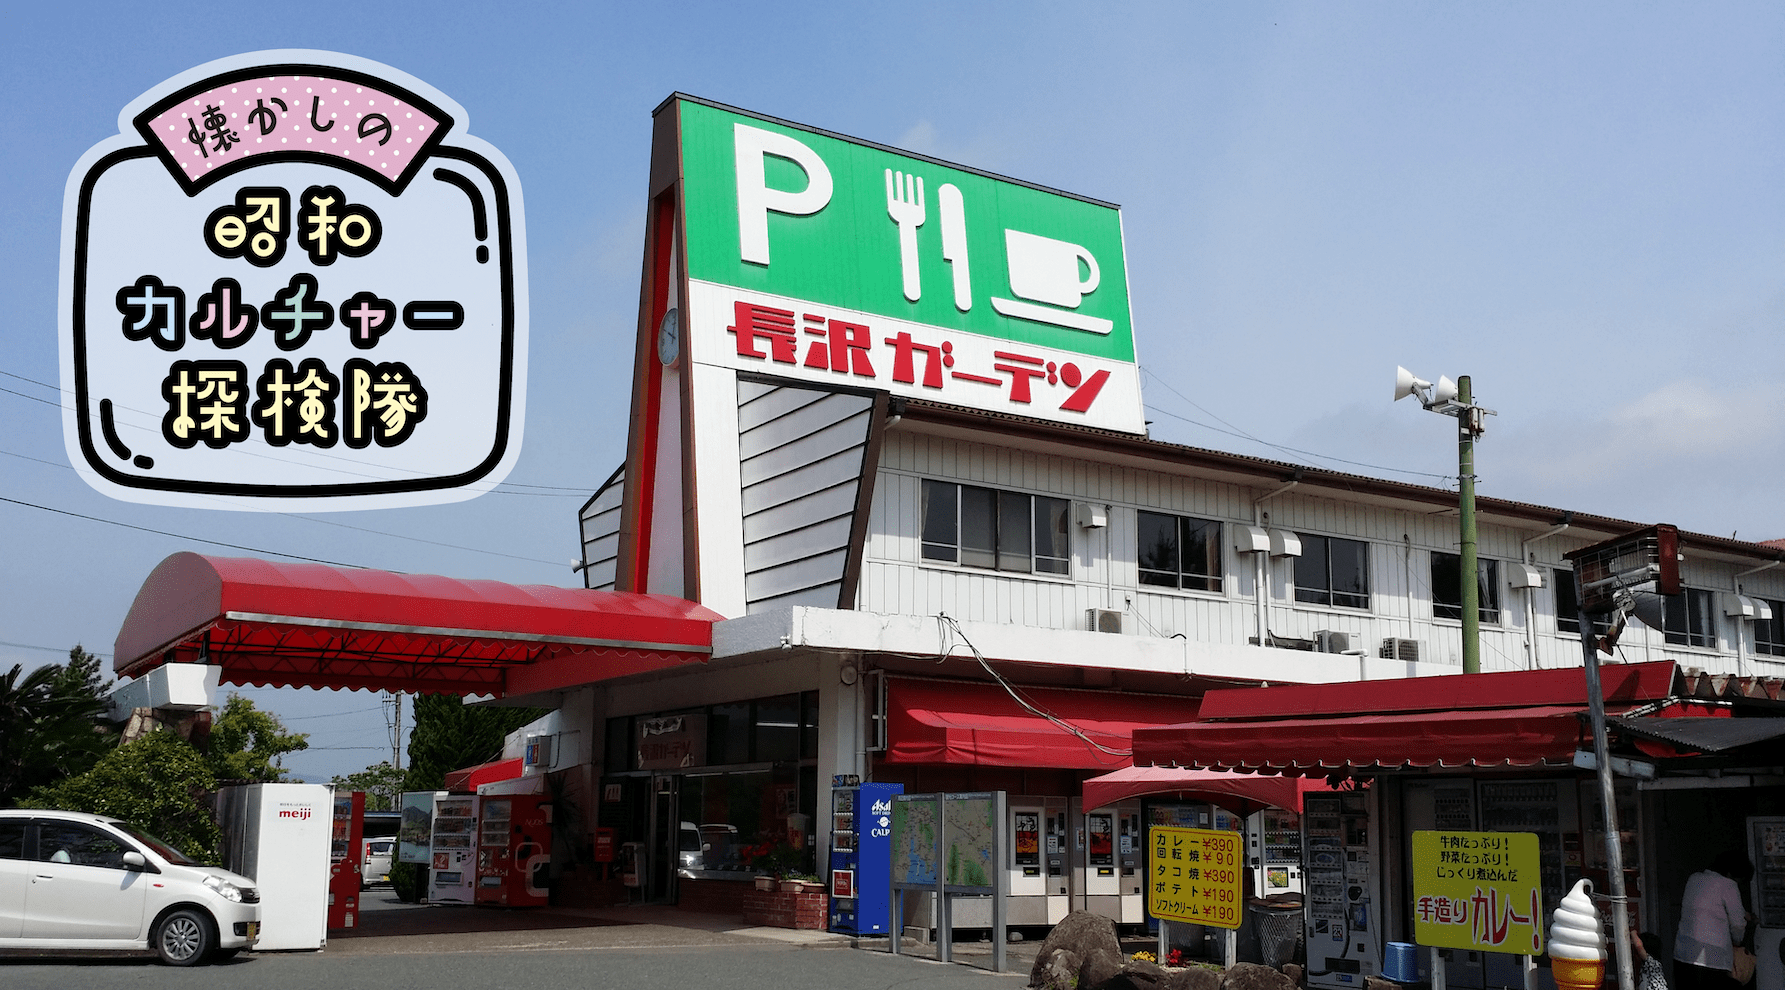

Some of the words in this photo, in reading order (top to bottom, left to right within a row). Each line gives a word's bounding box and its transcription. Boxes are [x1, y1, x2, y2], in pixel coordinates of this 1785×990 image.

[733, 122, 834, 266] P
[727, 300, 1111, 414] 長沢ガーデン
[279, 808, 311, 820] meiji
[1156, 833, 1200, 847] カレー
[1202, 837, 1234, 852] ¥390
[1440, 835, 1509, 851] 牛肉たっぷり!
[1156, 847, 1200, 863] 回転焼
[1440, 851, 1509, 867] 野菜たっぷり!
[1157, 864, 1200, 880] タコ焼
[1203, 868, 1235, 884] ¥390
[1436, 866, 1518, 882] じっくり煮込んだ
[1155, 881, 1199, 898] ポテト
[1202, 887, 1234, 903] ¥190
[1156, 898, 1199, 915] ソフトクリーム
[1202, 904, 1234, 921] ¥190
